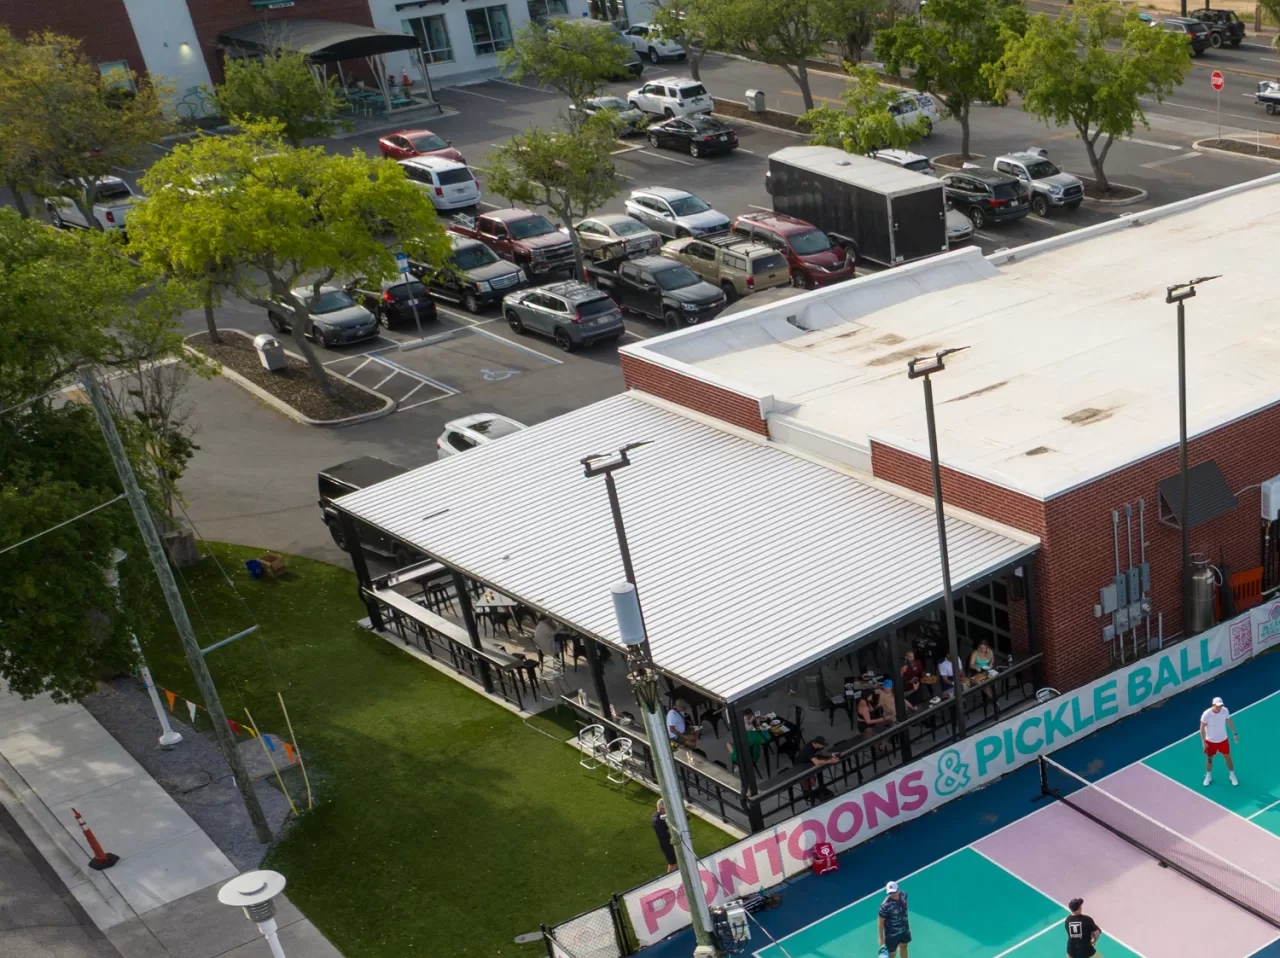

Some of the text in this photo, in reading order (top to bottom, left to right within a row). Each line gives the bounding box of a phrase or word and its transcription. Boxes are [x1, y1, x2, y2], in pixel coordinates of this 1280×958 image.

[638, 638, 1223, 935] PONTOONS & PICKLE BALL
